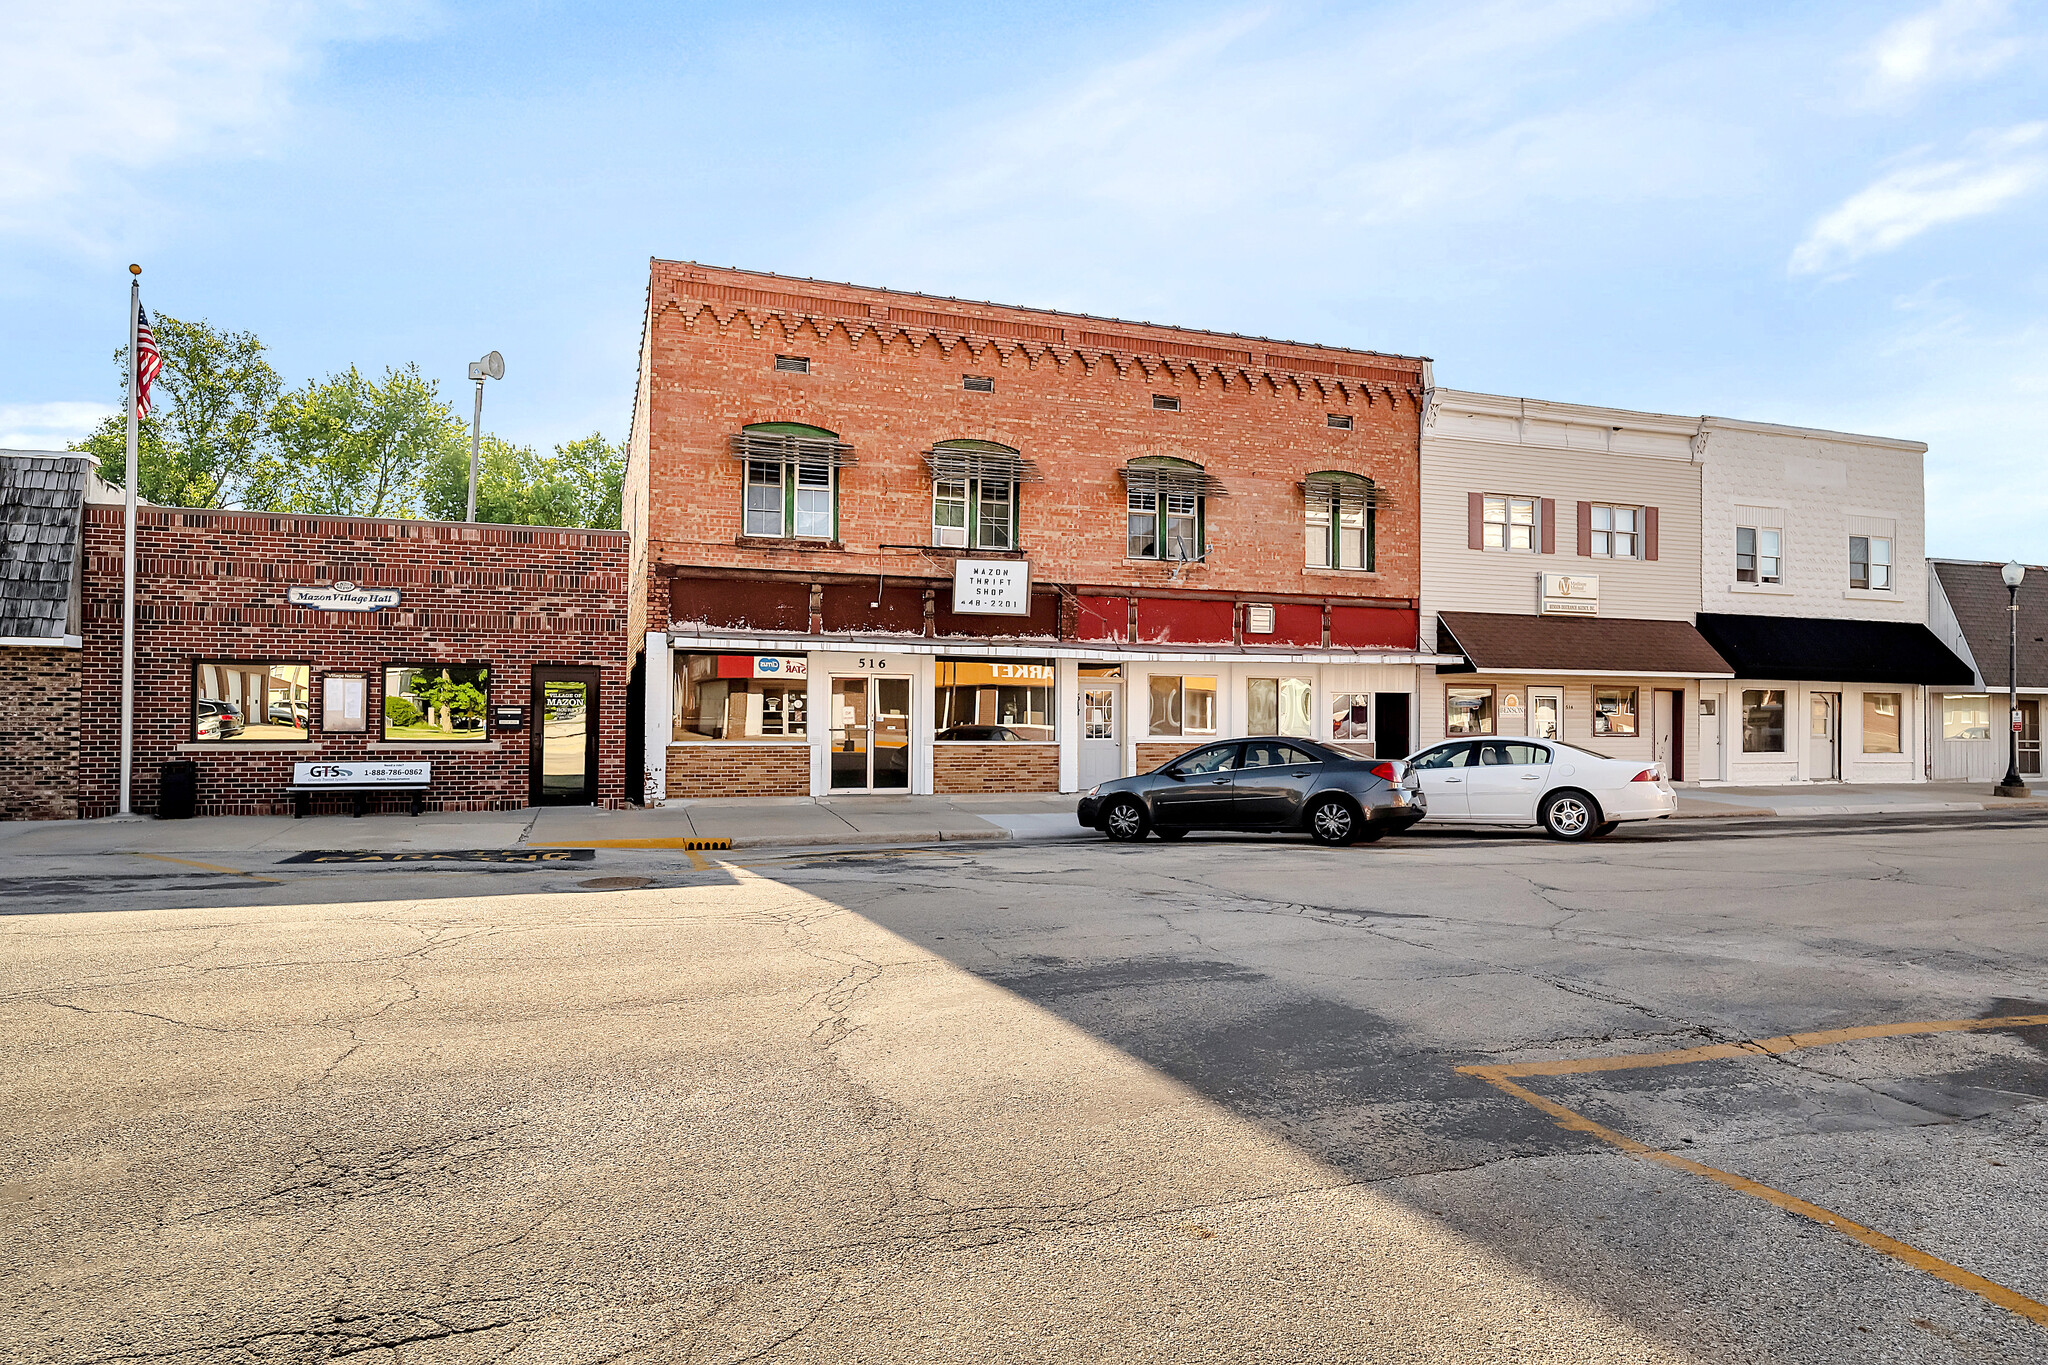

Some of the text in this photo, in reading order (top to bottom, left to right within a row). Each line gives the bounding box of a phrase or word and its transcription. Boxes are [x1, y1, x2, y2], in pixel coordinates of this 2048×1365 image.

[973, 568, 1009, 576] MAZON
[970, 577, 1011, 586] THRIFT
[976, 588, 1004, 596] SHOP
[297, 593, 393, 604] Mazon Village Hall
[858, 658, 886, 668] 516
[546, 698, 584, 706] MAZON
[310, 765, 340, 778] GTS
